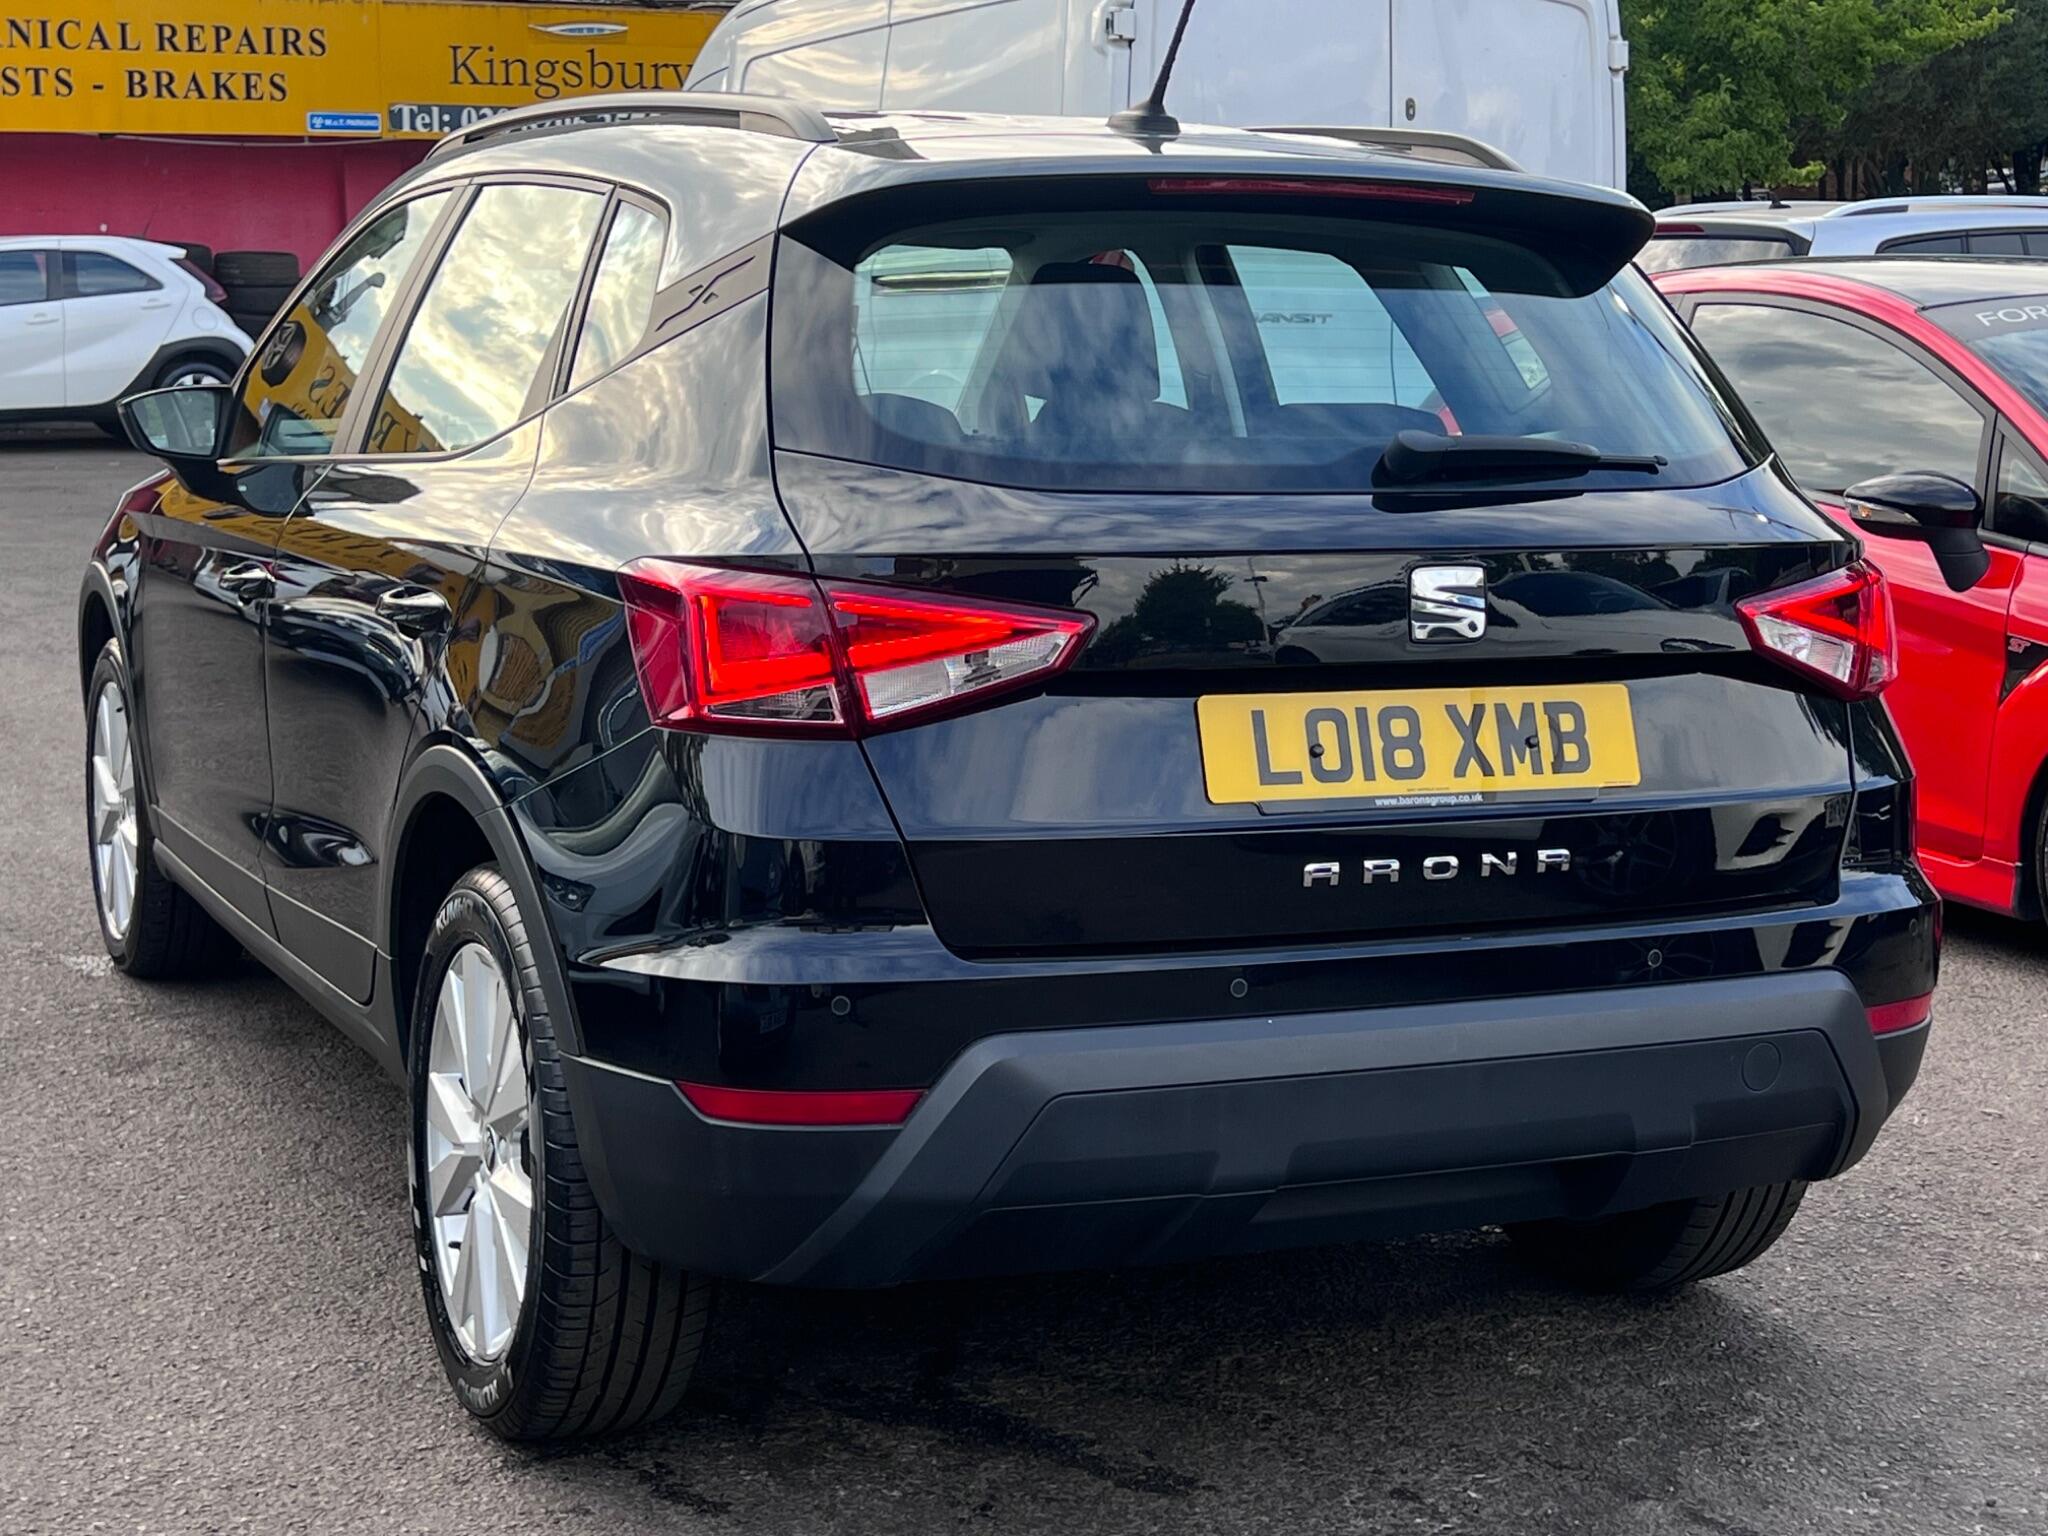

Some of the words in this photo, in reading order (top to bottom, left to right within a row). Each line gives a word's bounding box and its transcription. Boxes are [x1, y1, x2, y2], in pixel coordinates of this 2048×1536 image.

[0, 18, 141, 51] NICAL
[155, 23, 327, 57] REPAIRS
[1, 66, 74, 97] STS
[126, 70, 288, 102] BRAKES
[390, 104, 451, 132] Tel:
[1975, 304, 2048, 327] FOR
[1250, 704, 1426, 787] LO18
[1444, 700, 1592, 779] XMB
[1374, 792, 1484, 807] www.baronsgroup.co.uk
[1303, 848, 1572, 888] ARONA
